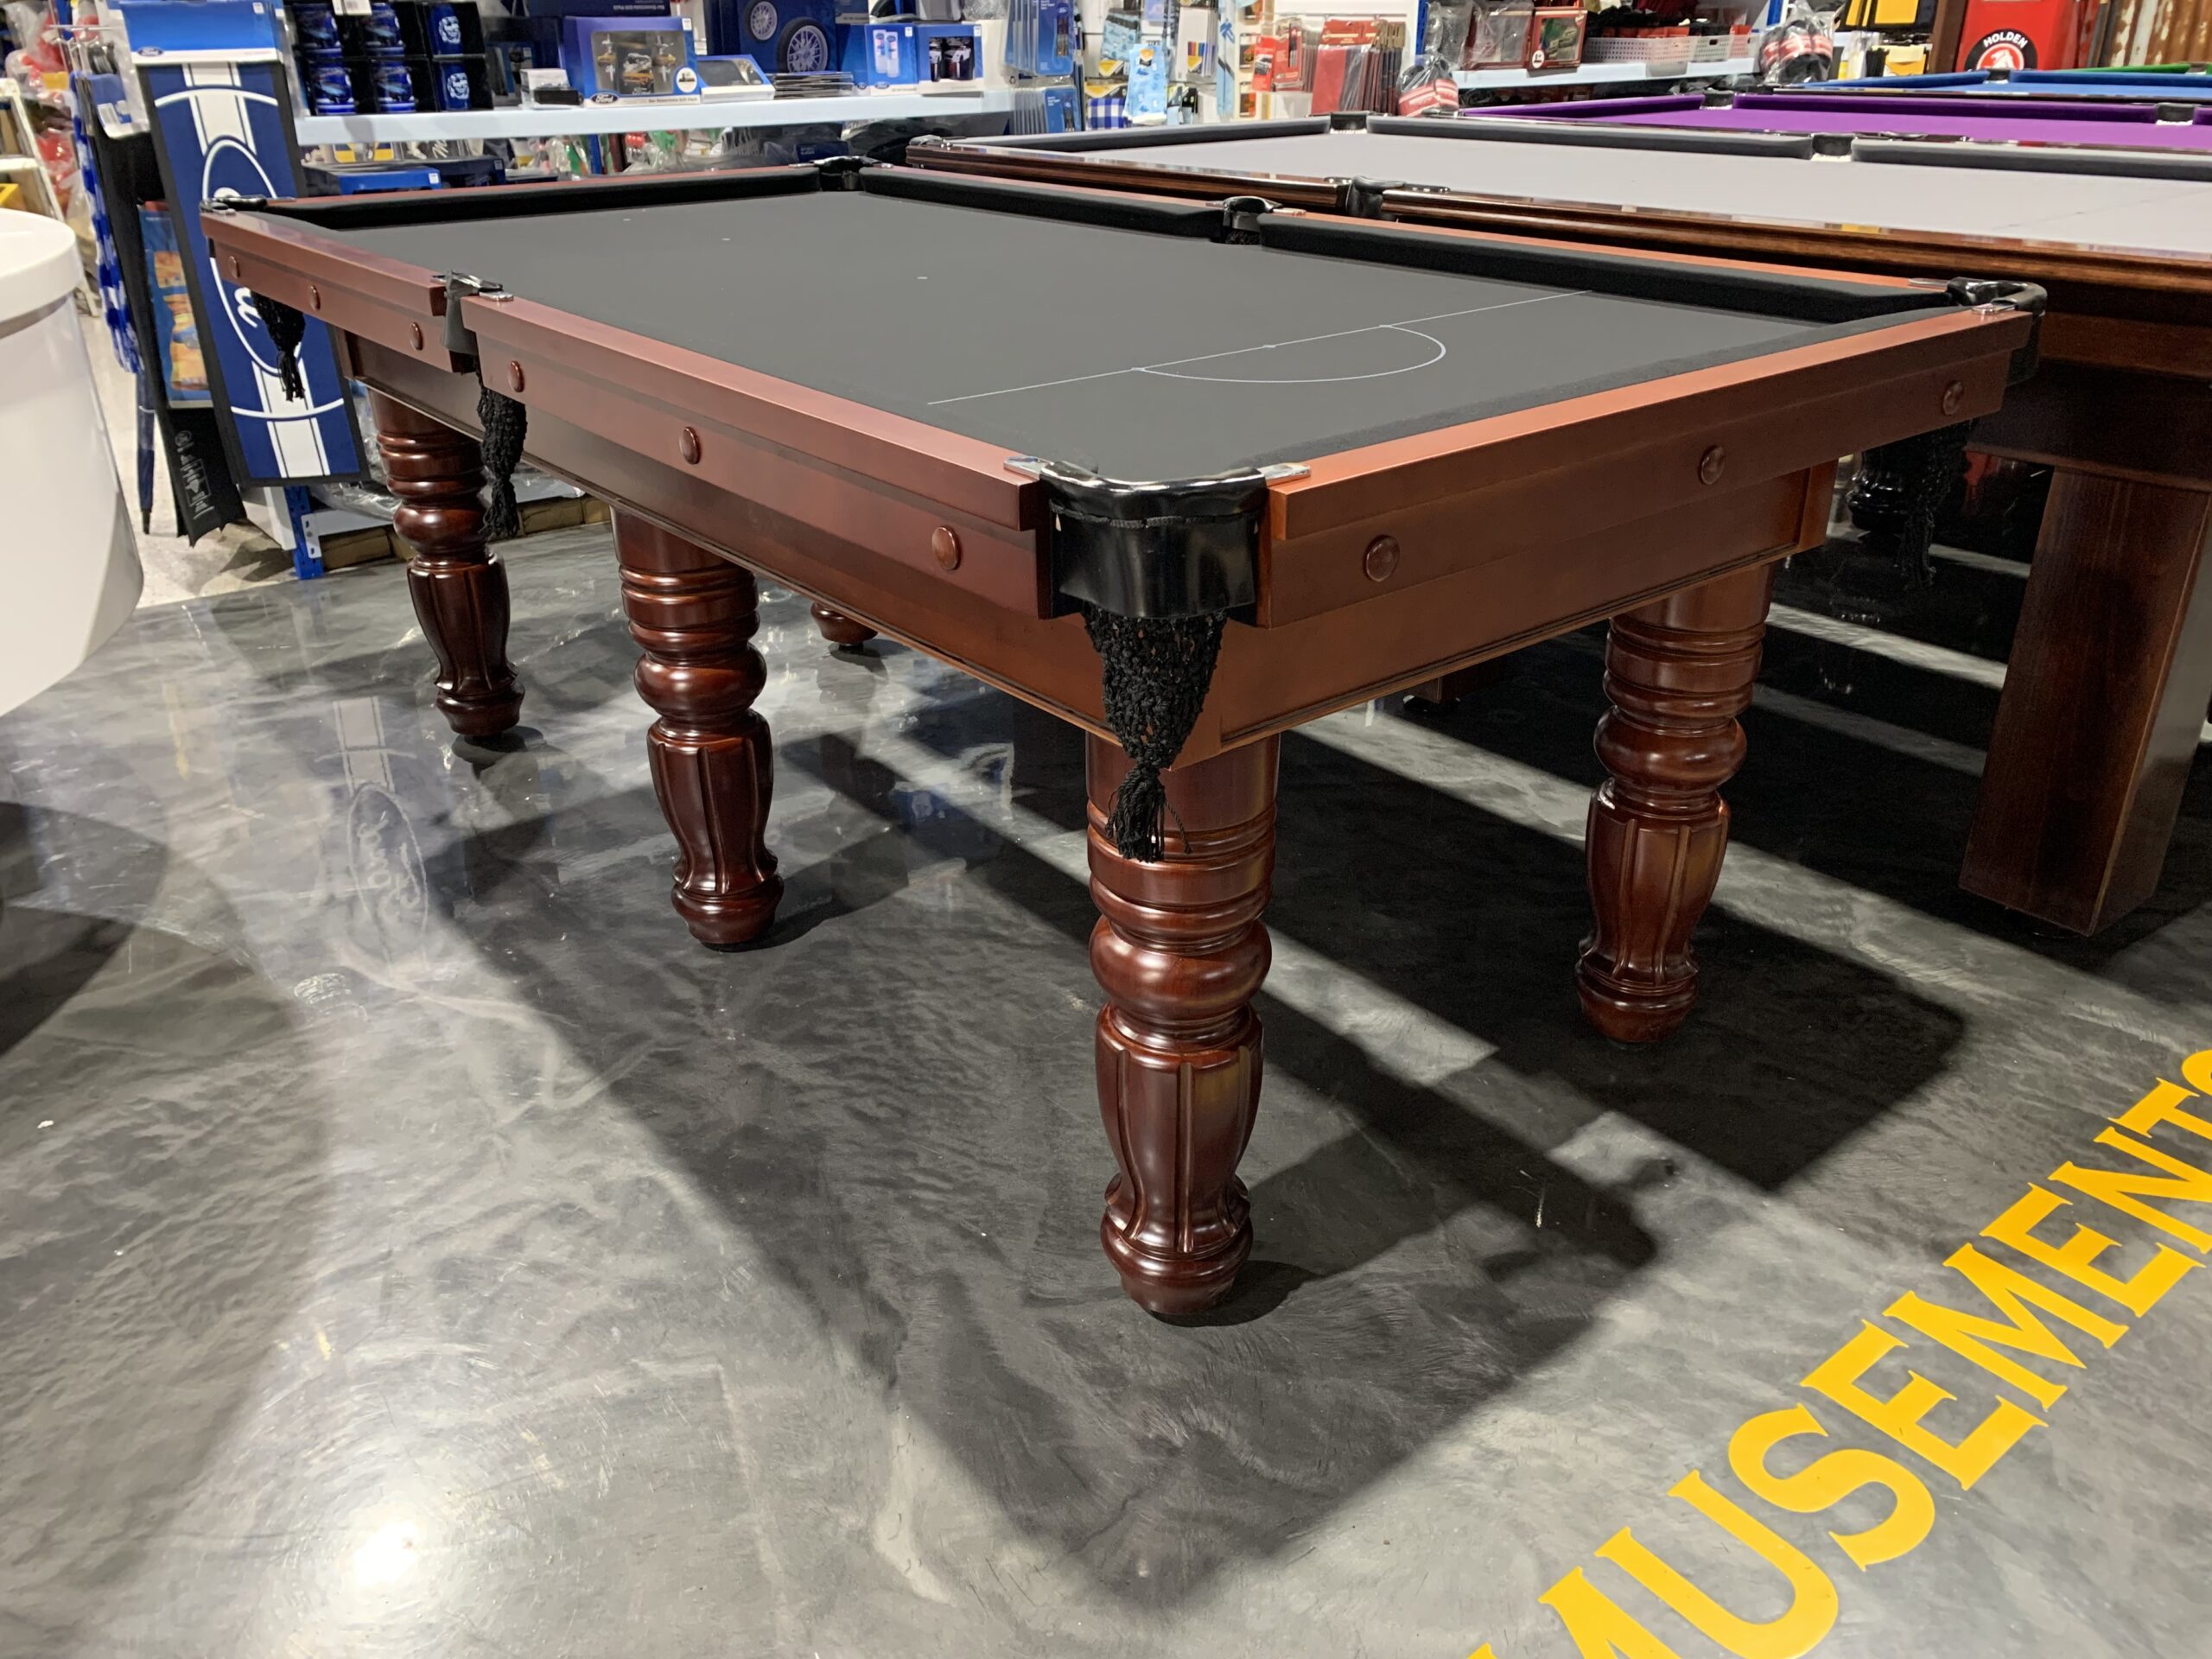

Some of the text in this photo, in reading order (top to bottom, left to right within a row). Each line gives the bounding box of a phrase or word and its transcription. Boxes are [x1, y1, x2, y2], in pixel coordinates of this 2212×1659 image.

[1982, 31, 2028, 48] HOLDEN
[595, 92, 615, 104] Ford
[1466, 1049, 2212, 1659] USEMENT
